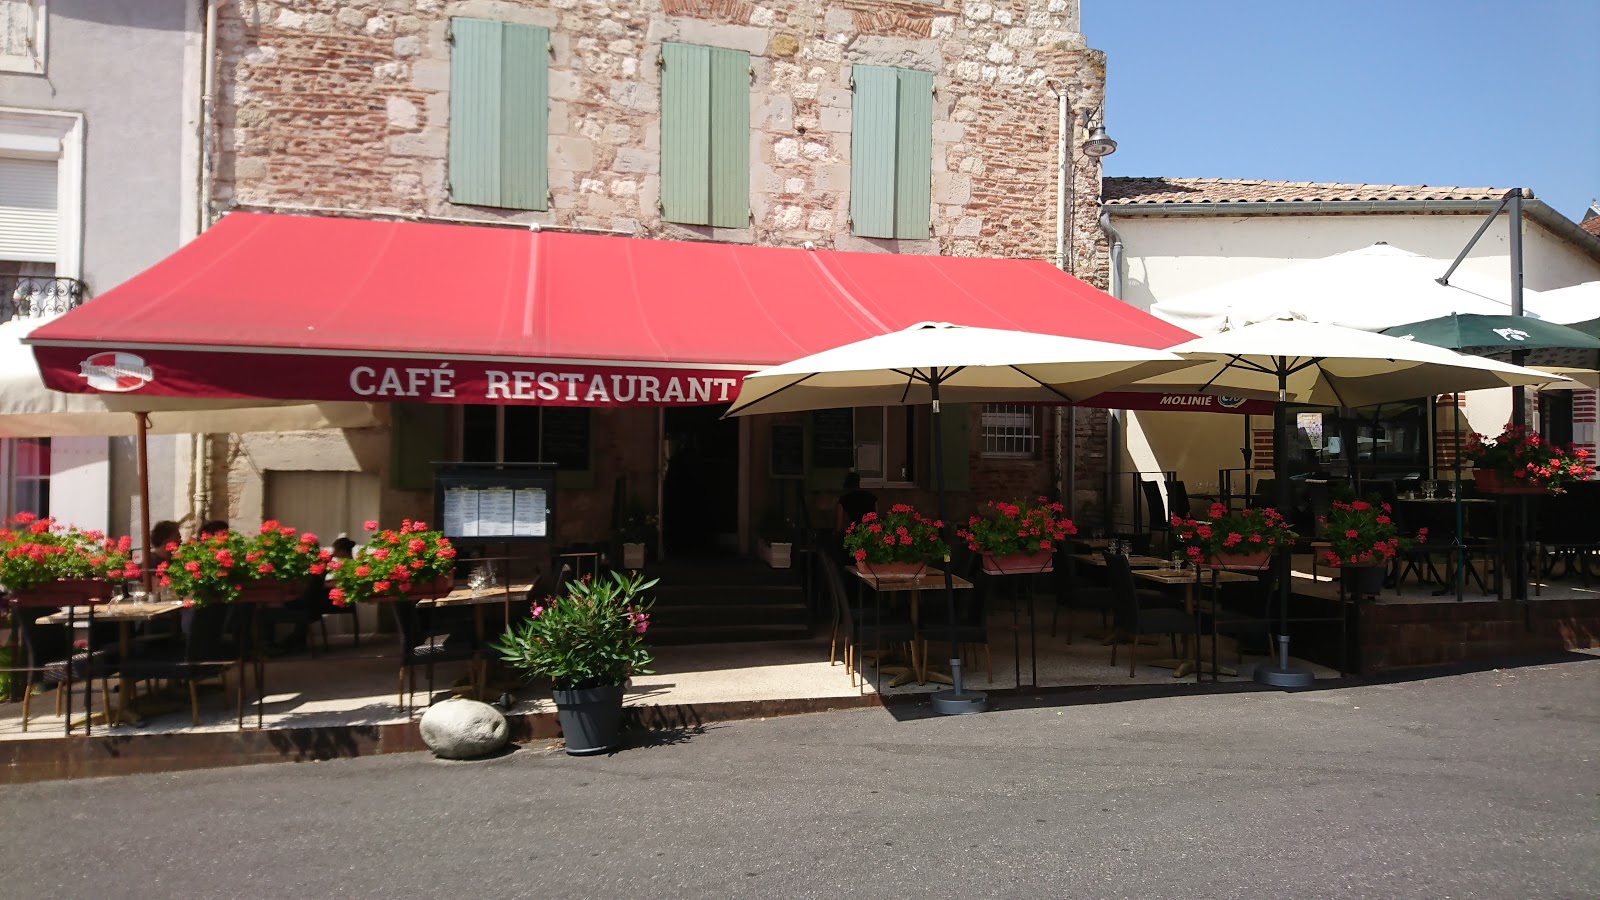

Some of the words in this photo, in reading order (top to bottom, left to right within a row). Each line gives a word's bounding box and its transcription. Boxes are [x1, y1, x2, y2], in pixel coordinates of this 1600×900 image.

[350, 363, 455, 398] CAFÉ
[486, 370, 736, 402] RESTAURANT
[1159, 395, 1213, 406] MOLINIÉ
